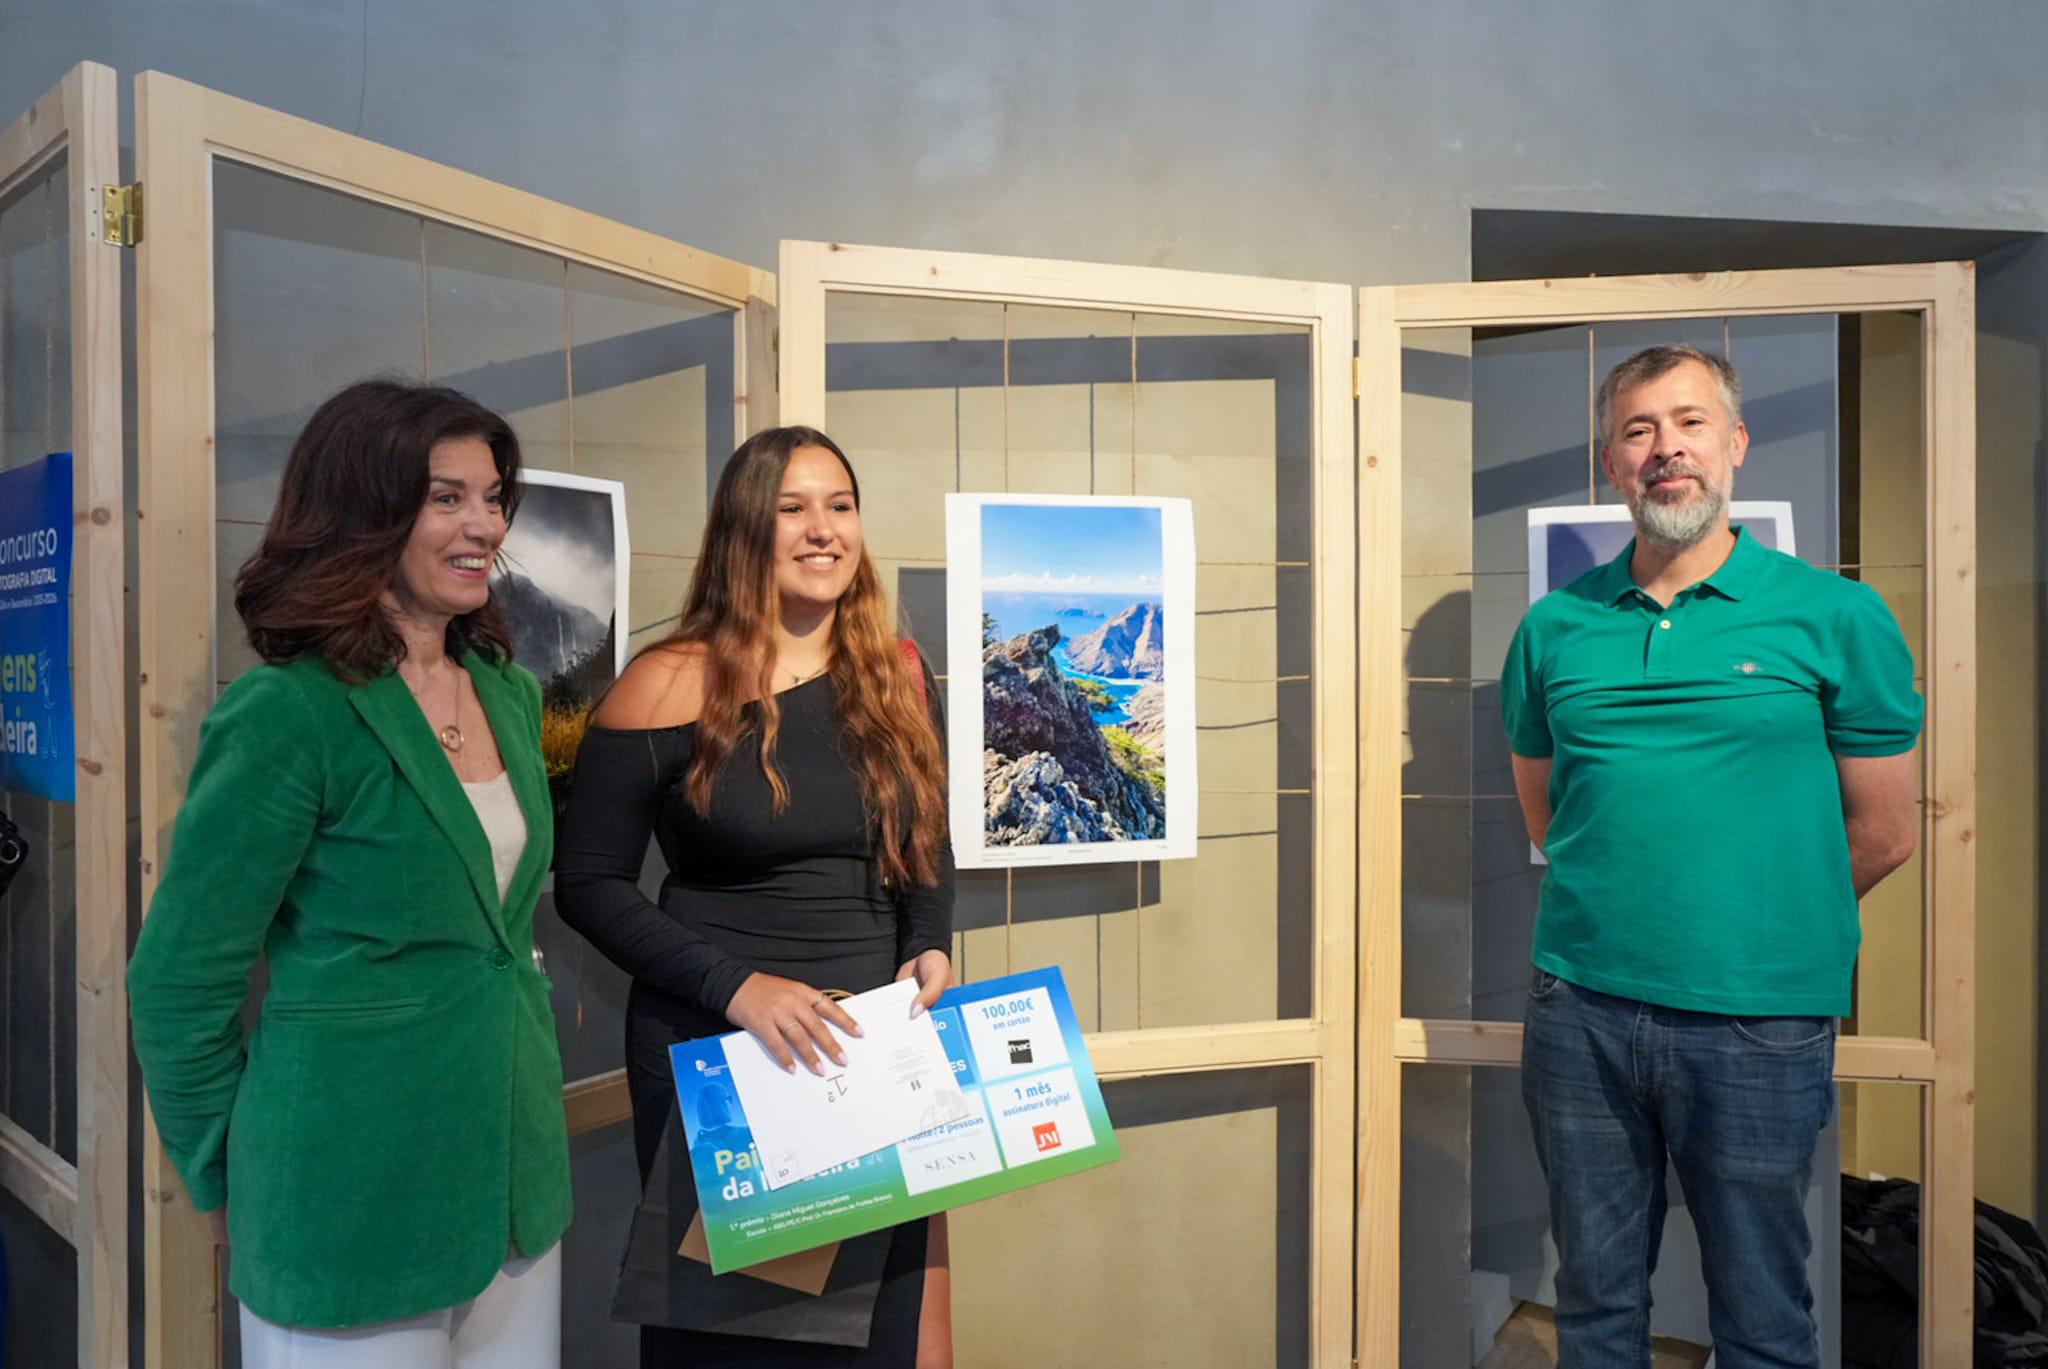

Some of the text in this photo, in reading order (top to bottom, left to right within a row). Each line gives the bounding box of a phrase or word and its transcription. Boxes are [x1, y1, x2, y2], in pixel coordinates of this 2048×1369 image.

[982, 997, 1035, 1019] 100,00€
[993, 1022, 1005, 1030] em
[1014, 1081, 1052, 1100] 1 mês
[1003, 1092, 1071, 1117] assinatura digital
[947, 1117, 984, 1134] pessoas
[722, 1176, 754, 1200] da
